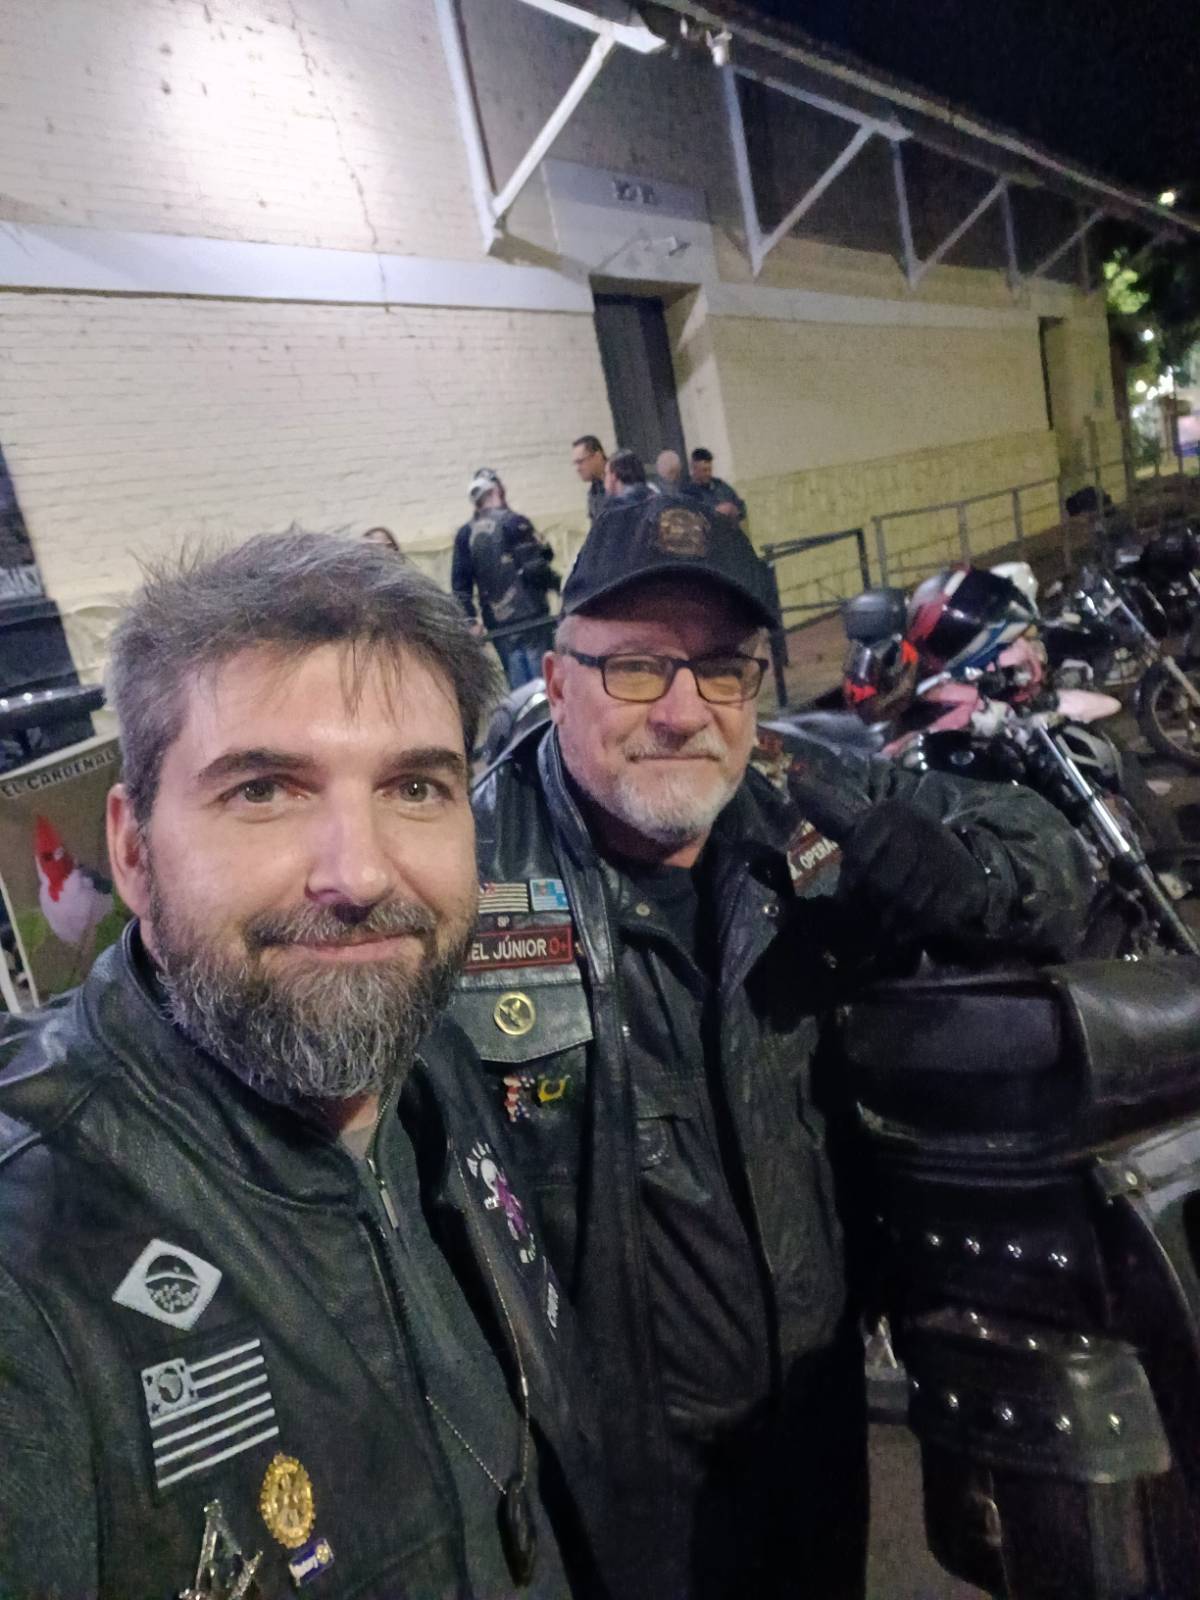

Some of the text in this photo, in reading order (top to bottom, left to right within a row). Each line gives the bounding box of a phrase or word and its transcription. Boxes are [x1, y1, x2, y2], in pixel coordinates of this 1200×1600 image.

[1, 782, 21, 797] EL
[469, 942, 490, 961] EL
[493, 935, 547, 960] JÚNIOR
